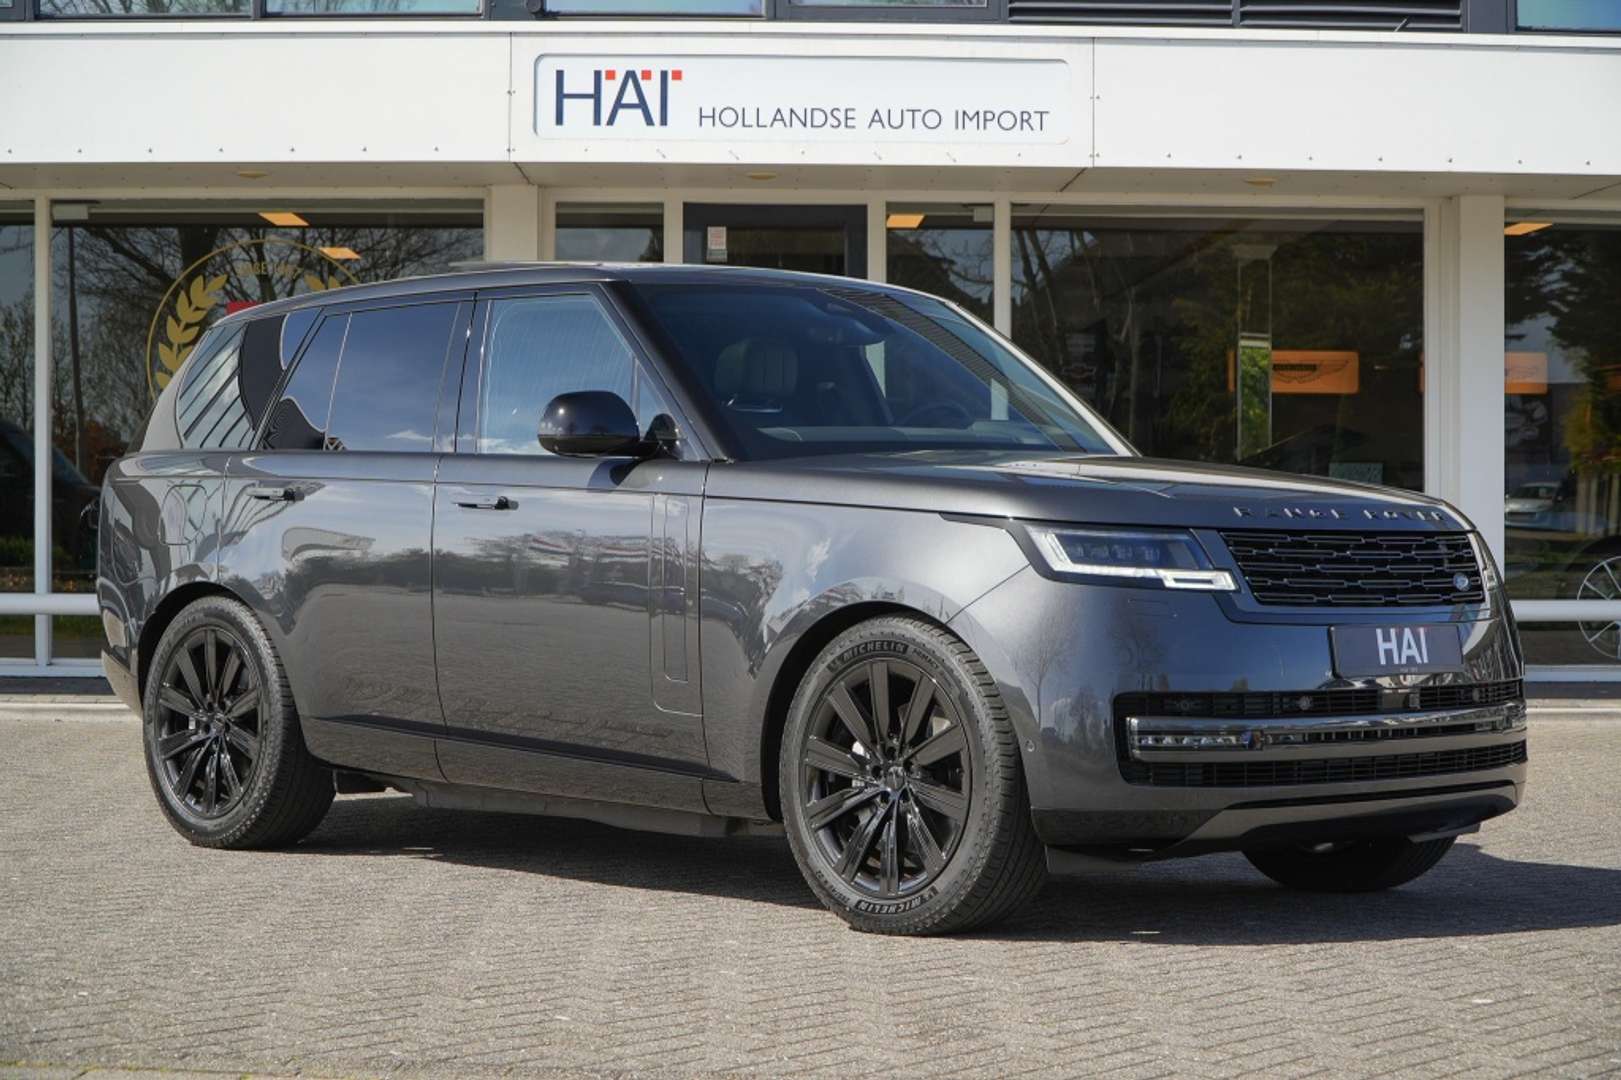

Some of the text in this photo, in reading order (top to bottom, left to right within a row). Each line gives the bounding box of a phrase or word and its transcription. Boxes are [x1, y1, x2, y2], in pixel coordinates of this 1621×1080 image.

[555, 69, 669, 127] HAI
[699, 106, 1050, 131] HOLLANDSE AUTO IMPORT
[1375, 627, 1430, 665] HAI
